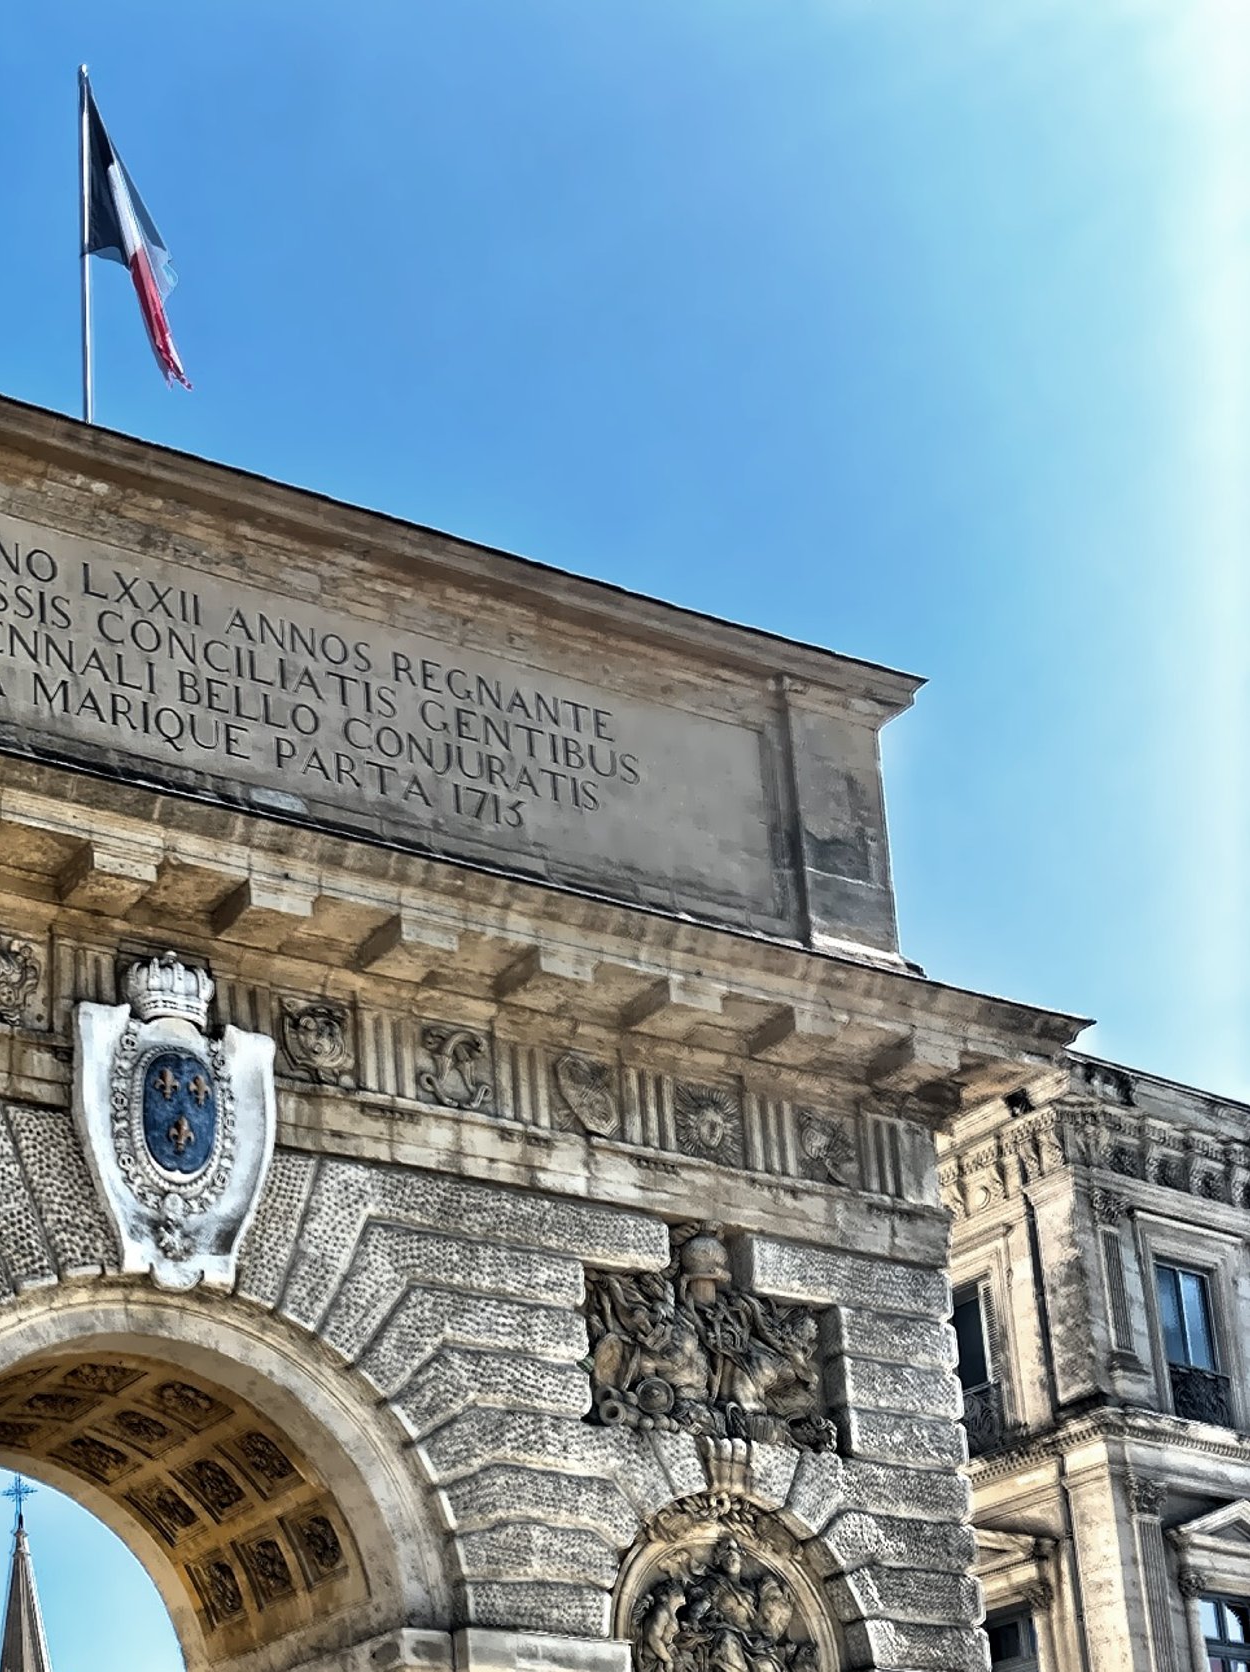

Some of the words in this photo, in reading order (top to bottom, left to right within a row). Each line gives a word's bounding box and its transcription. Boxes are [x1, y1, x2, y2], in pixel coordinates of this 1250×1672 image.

[82, 562, 202, 626] LXXII
[225, 608, 373, 672] ANNOS
[393, 652, 615, 742] REGNANTE
[97, 611, 397, 717] CONCILIATIS
[420, 700, 640, 785] GENTIBUS
[32, 671, 253, 760] MARIQUE
[275, 736, 432, 808] PARTA
[453, 783, 526, 828] 1715
[180, 669, 320, 736] BELLO
[344, 718, 600, 811] CONJURATIS
